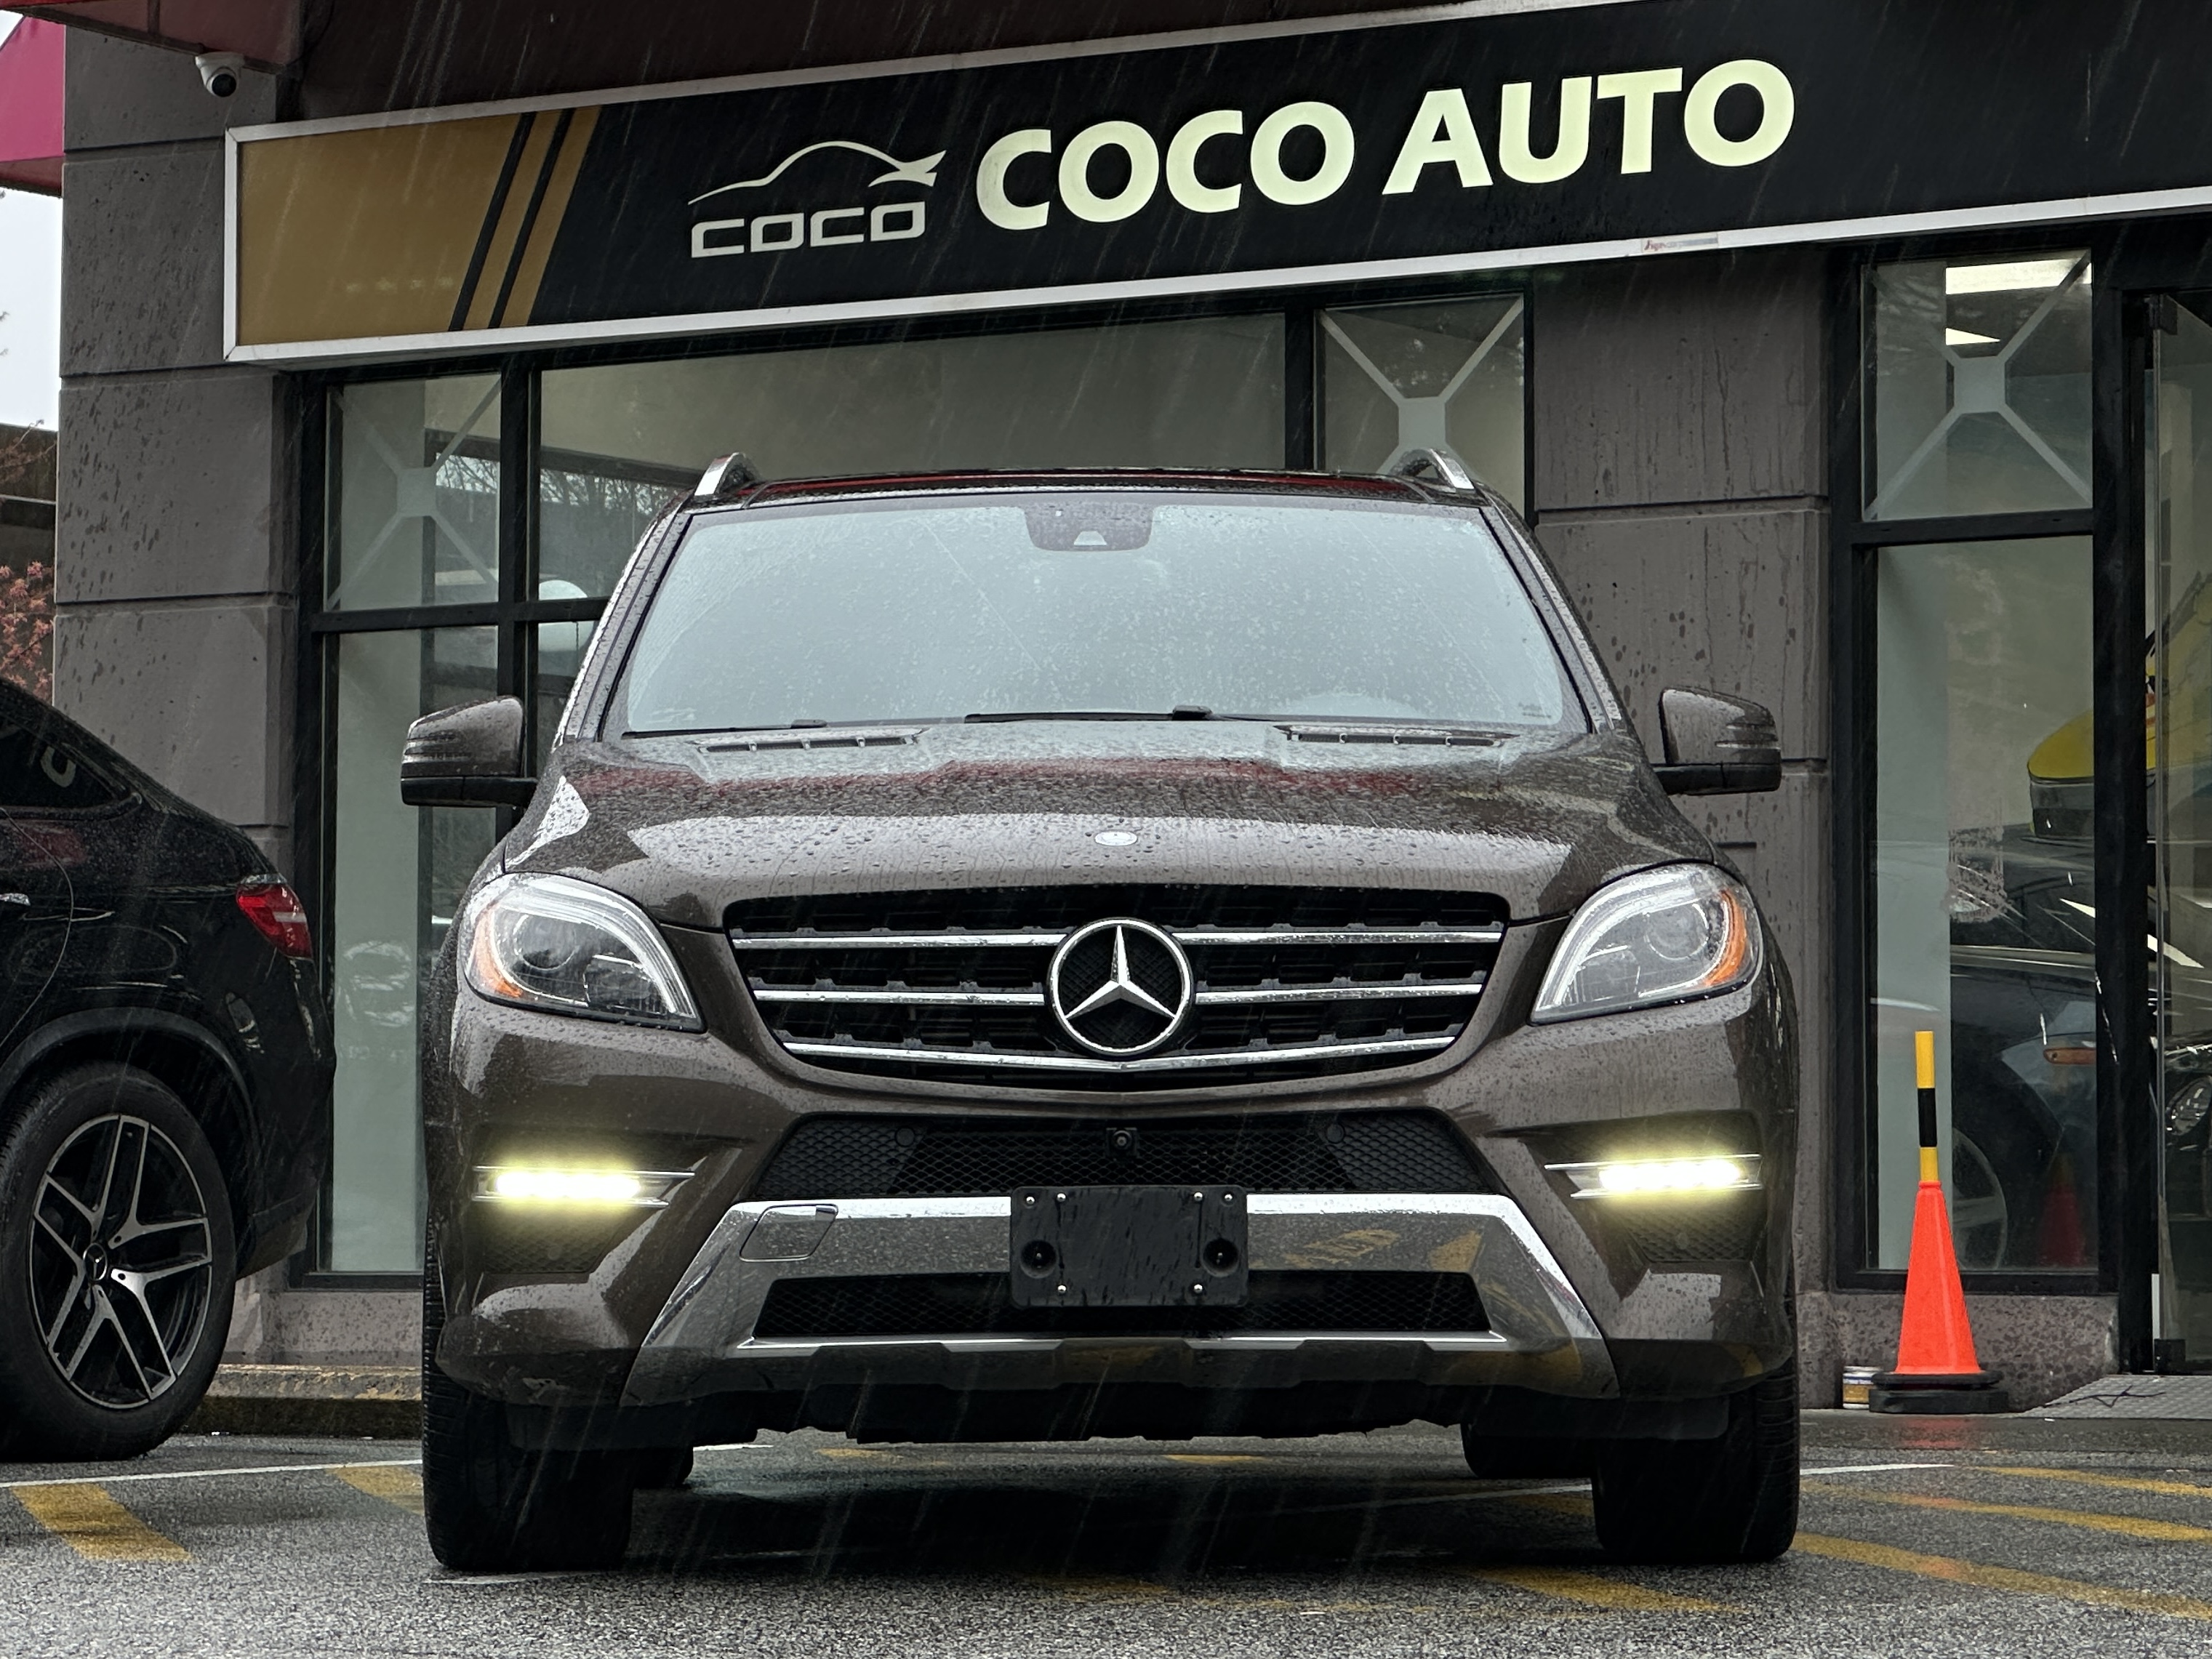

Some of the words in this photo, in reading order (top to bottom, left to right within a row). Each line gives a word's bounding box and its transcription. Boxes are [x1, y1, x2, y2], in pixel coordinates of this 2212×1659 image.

[977, 88, 1355, 230] COCO
[1382, 59, 1795, 196] AUTO
[691, 201, 926, 258] COCO
